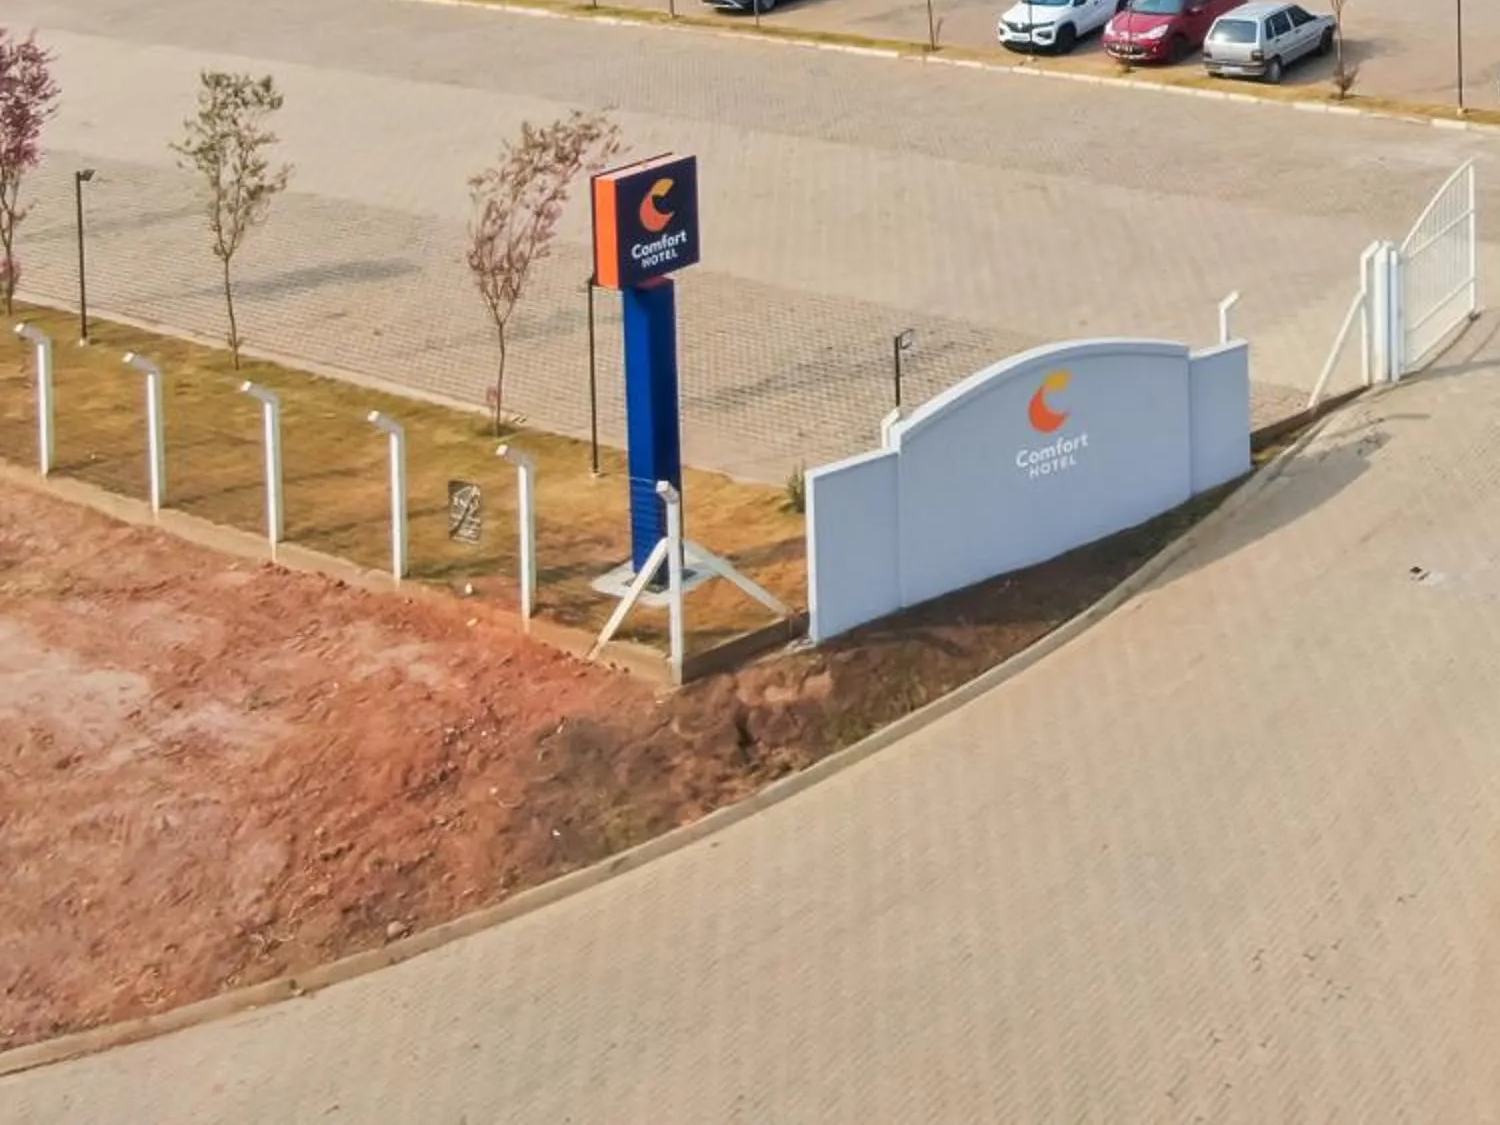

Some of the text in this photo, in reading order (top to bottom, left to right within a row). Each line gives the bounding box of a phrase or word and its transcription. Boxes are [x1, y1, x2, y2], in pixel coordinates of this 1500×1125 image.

[631, 229, 687, 259] Comfort
[641, 248, 679, 268] HOTEL
[1016, 432, 1088, 468] Comfort
[1029, 454, 1077, 478] HOTEL
